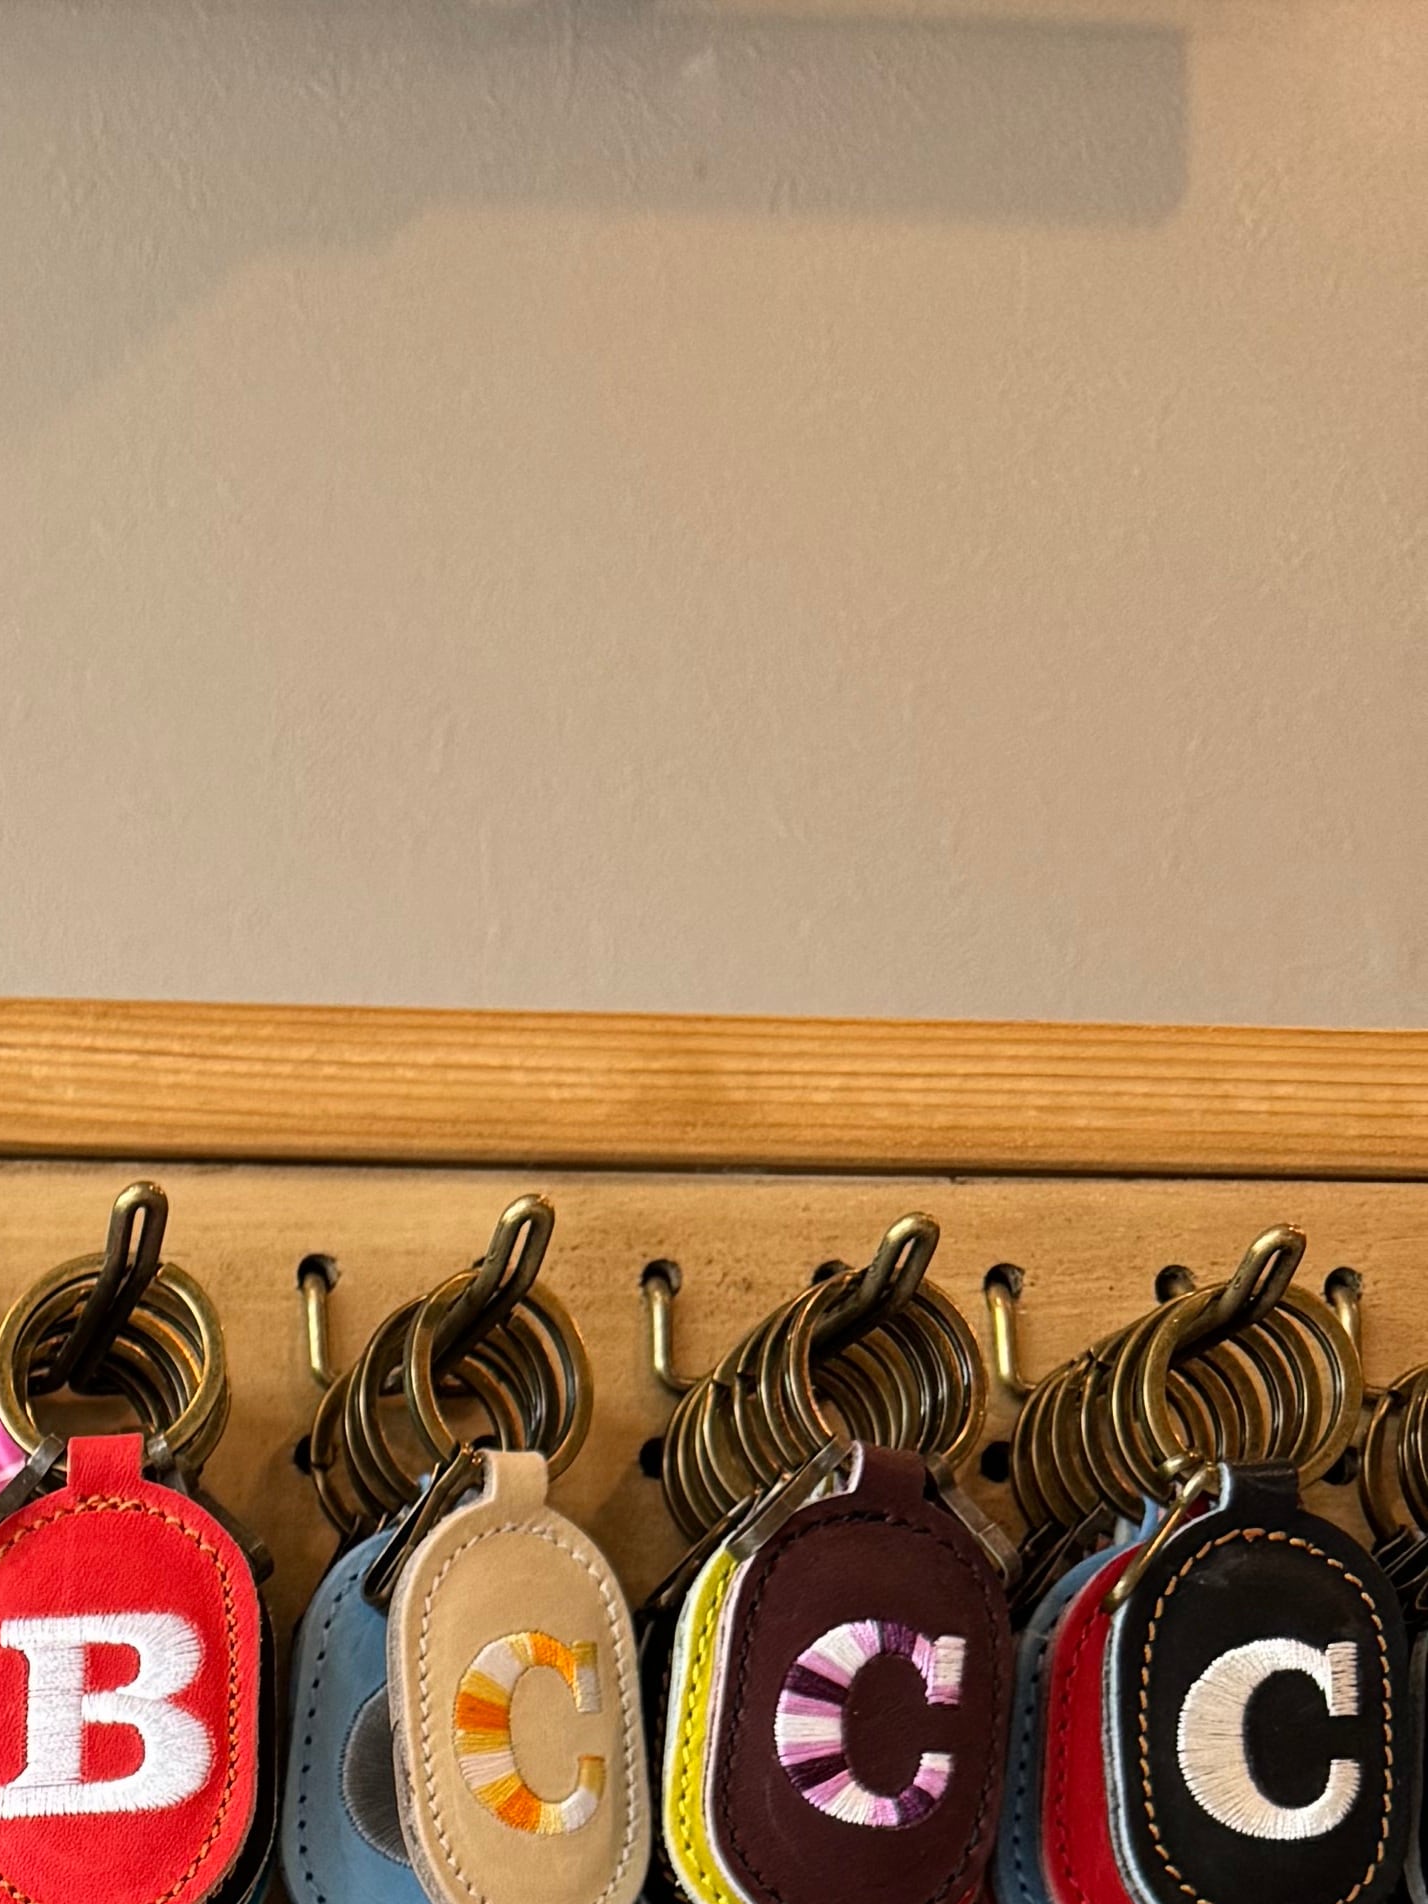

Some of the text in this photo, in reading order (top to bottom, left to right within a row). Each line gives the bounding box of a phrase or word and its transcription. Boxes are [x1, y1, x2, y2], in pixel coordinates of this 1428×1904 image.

[454, 1629, 607, 1835] C
[774, 1618, 966, 1830] C
[1176, 1636, 1363, 1841] C
